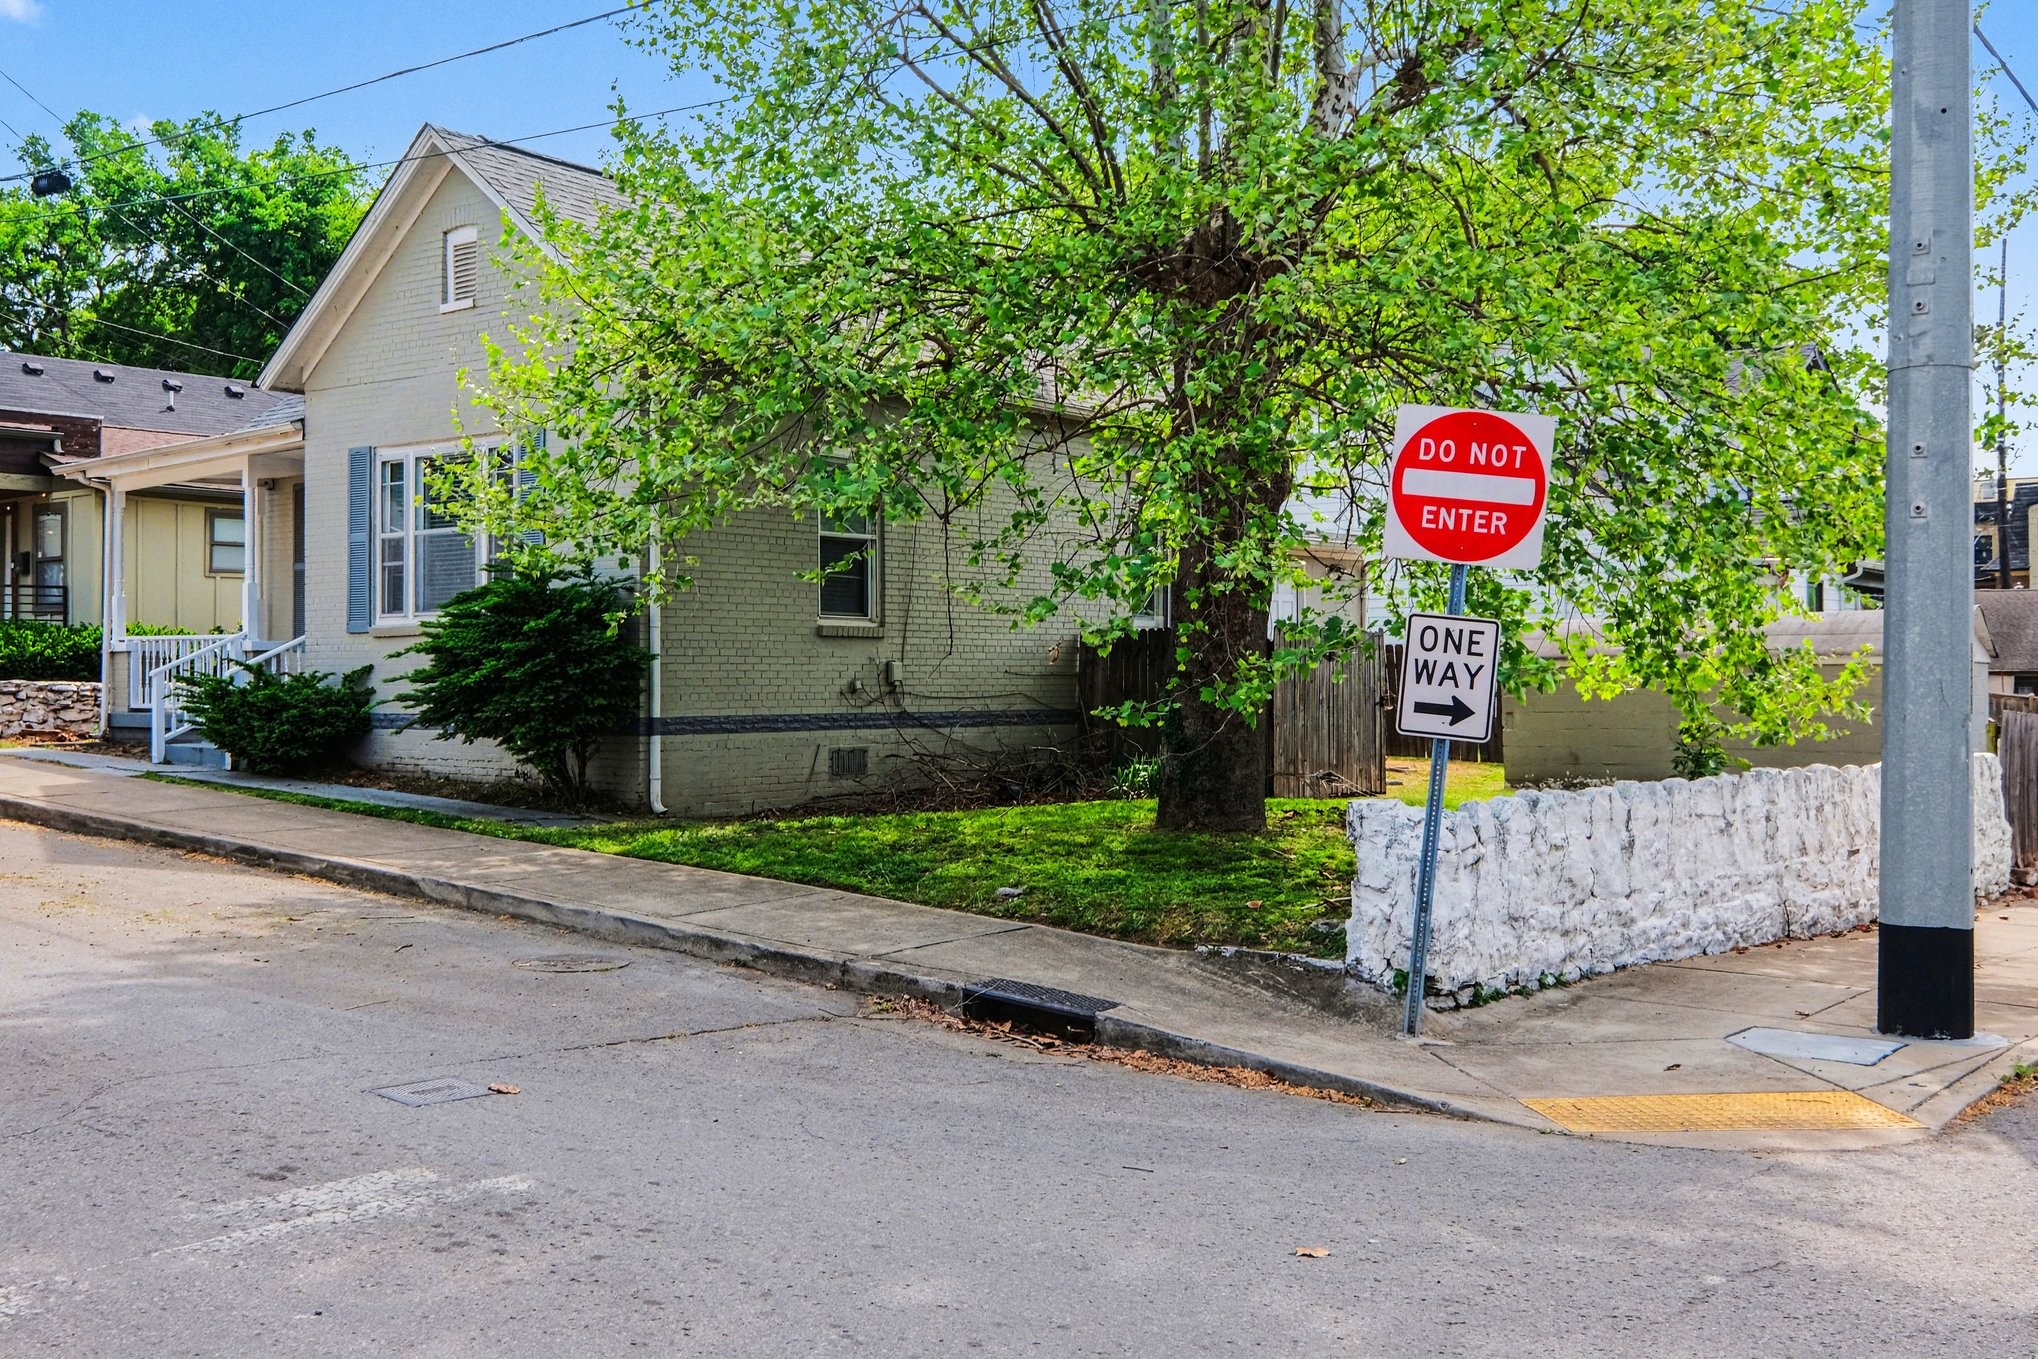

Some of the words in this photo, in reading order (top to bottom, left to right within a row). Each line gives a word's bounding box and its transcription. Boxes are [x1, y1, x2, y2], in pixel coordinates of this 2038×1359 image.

[1419, 438, 1456, 463] DO
[1469, 442, 1527, 468] NOT
[1421, 505, 1508, 535] ENTER
[1419, 624, 1485, 657] ONE
[1414, 658, 1485, 690] WAY
